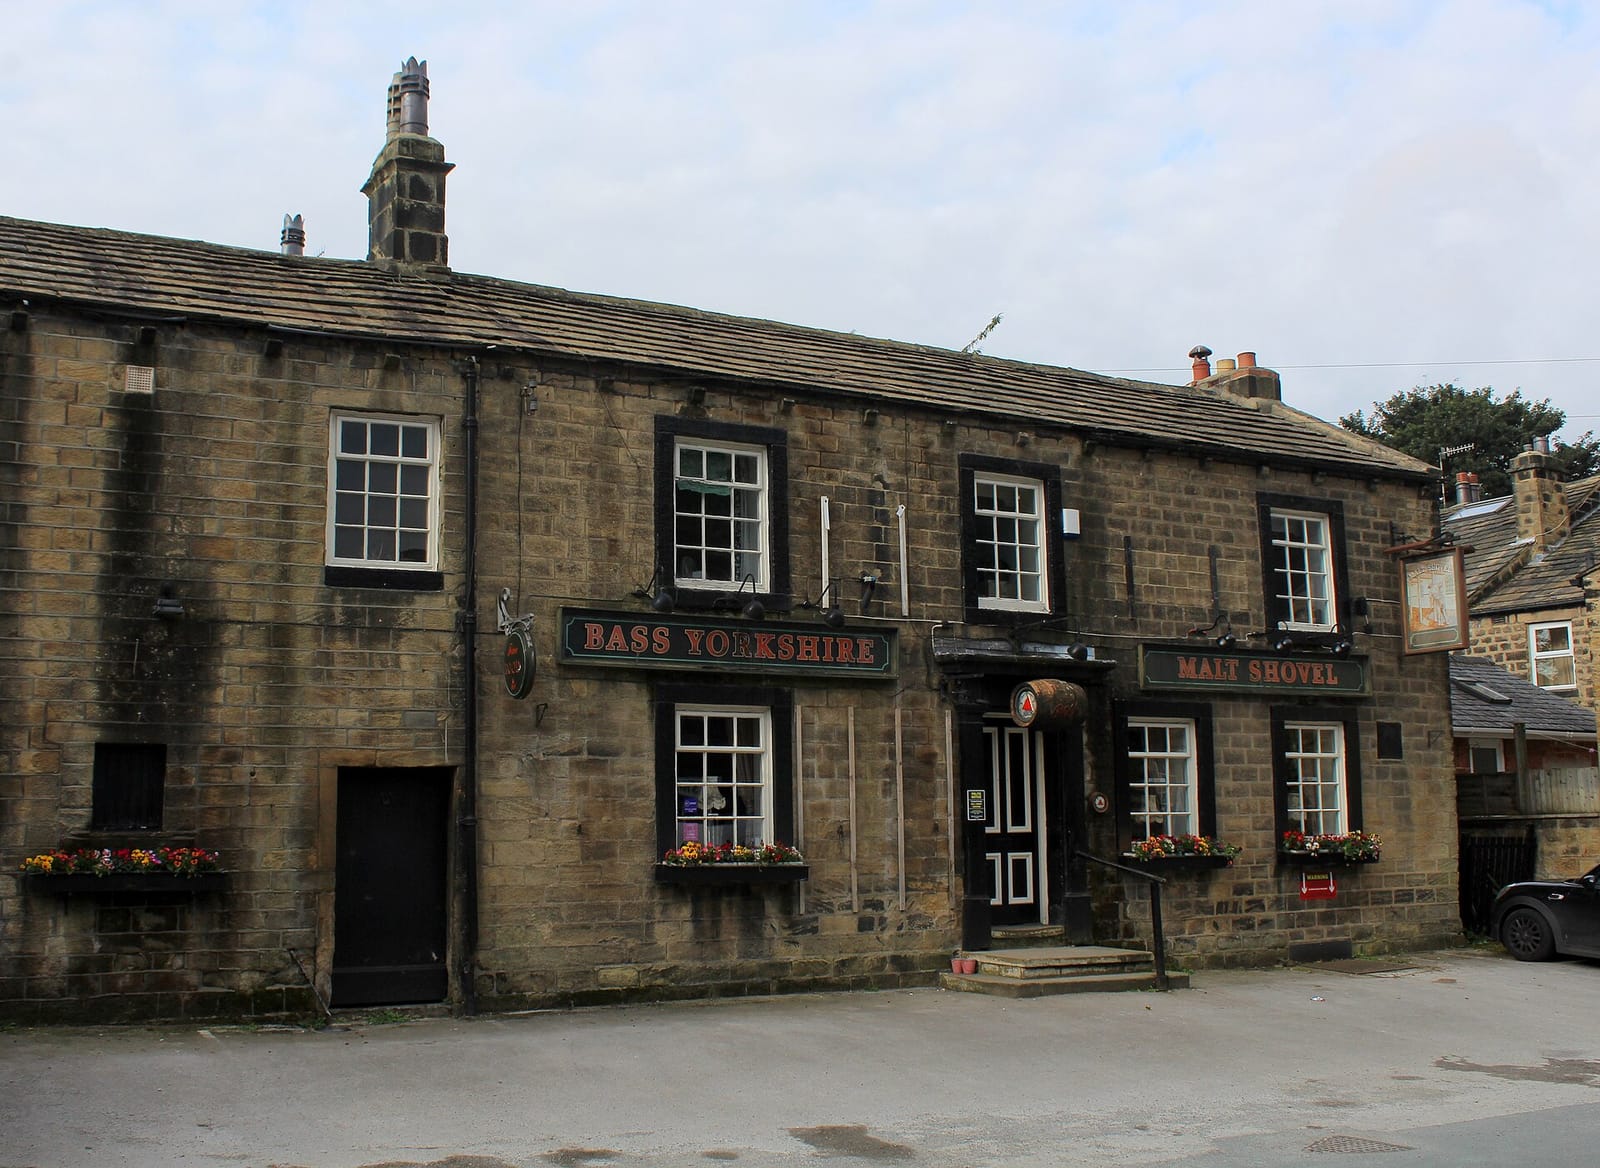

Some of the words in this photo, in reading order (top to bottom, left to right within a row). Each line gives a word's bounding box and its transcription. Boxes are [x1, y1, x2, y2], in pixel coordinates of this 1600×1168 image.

[584, 623, 671, 654] BASS
[684, 629, 875, 664] YORKSHIRE
[1177, 656, 1240, 681] MALT
[1249, 660, 1339, 685] SHOVEL
